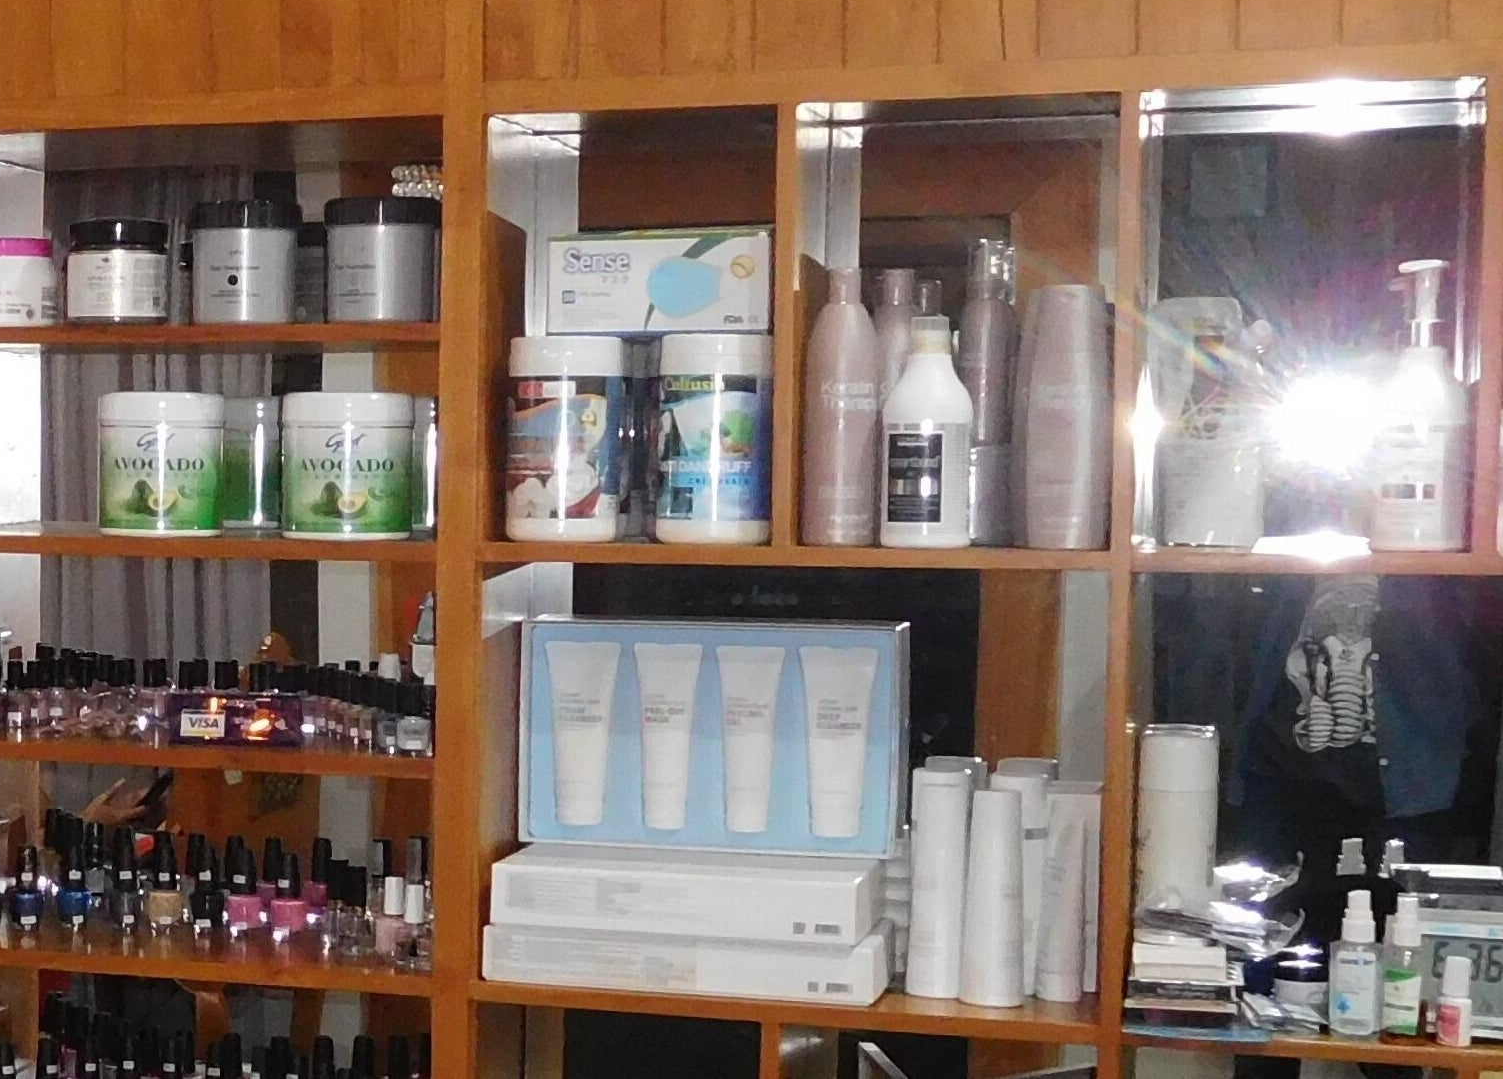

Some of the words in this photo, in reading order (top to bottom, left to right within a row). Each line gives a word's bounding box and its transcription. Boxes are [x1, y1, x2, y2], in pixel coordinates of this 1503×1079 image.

[563, 248, 629, 273] Sense
[114, 457, 204, 471] AVOCADO
[302, 458, 394, 472] AVOCADO
[188, 717, 219, 729] VISA
